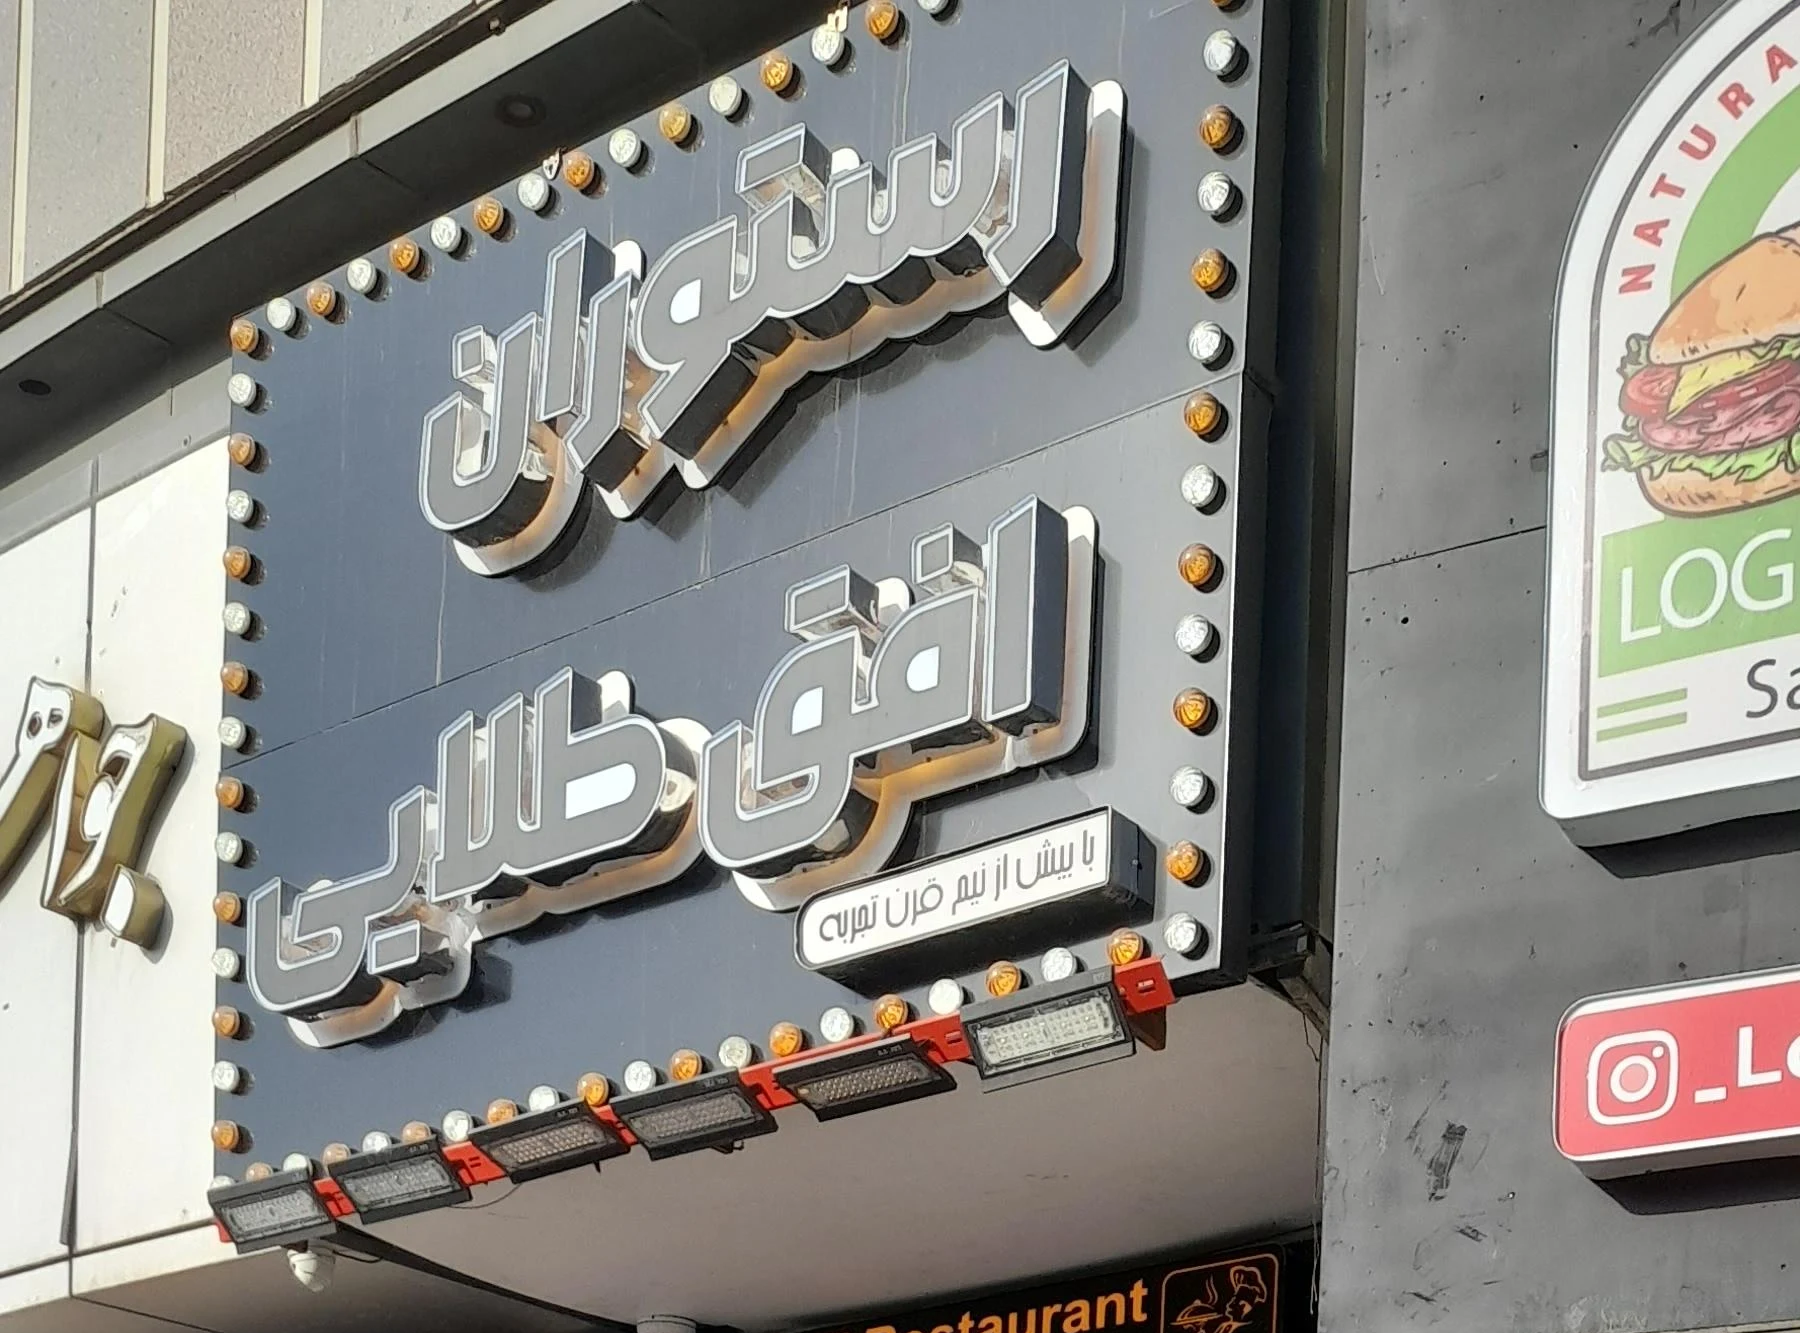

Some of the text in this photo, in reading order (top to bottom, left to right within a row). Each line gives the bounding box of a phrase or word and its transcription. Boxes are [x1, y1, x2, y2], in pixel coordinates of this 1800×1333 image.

[1619, 44, 1799, 294] NATURA
[417, 58, 1100, 540] رستوران
[1620, 528, 1795, 644] LOG
[246, 493, 1072, 1013] افق طلایی
[818, 829, 1096, 945] با بیش از نیم قرن تجربه
